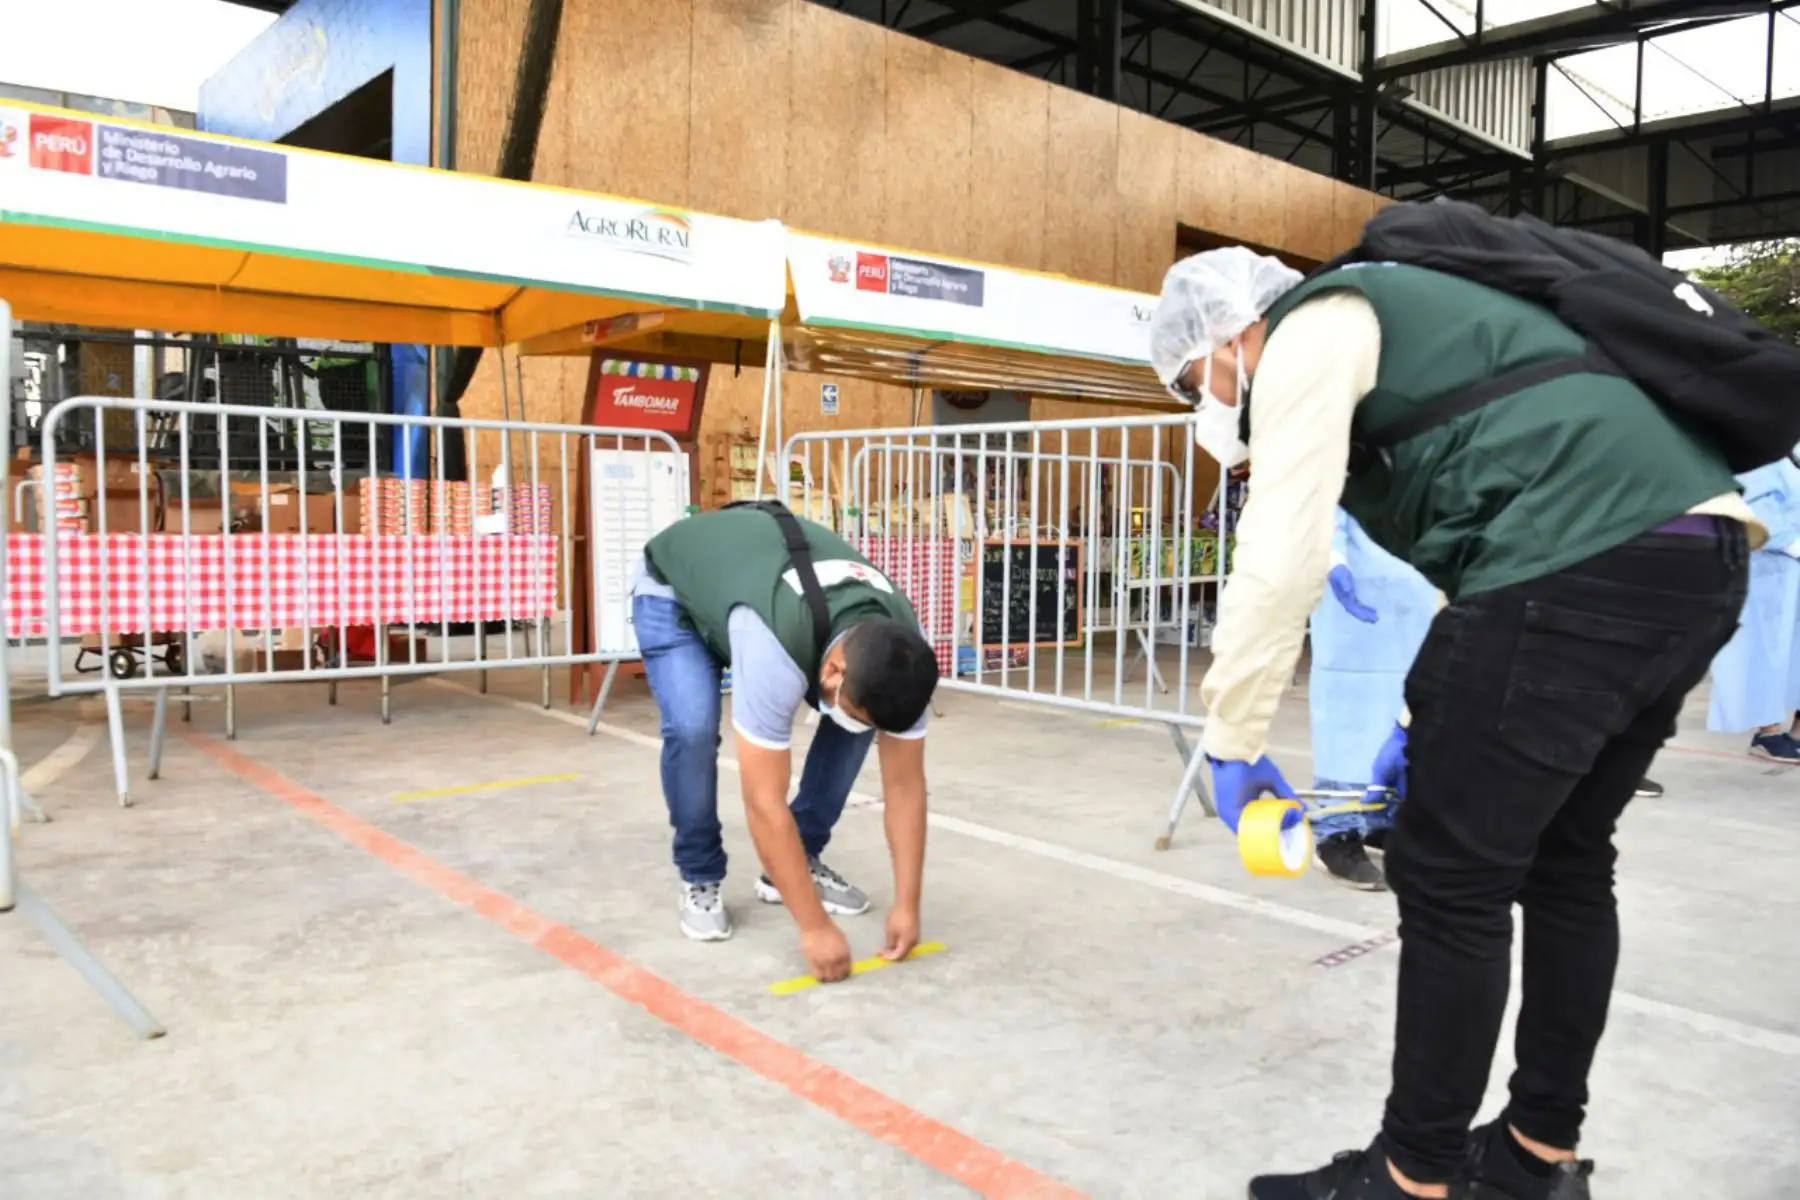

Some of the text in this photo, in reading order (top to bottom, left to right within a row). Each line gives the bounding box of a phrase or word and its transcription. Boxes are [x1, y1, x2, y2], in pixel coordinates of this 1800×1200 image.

[103, 131, 180, 156] Ministerio
[102, 146, 258, 181] de Desarrollo Agrario
[102, 161, 112, 175] y
